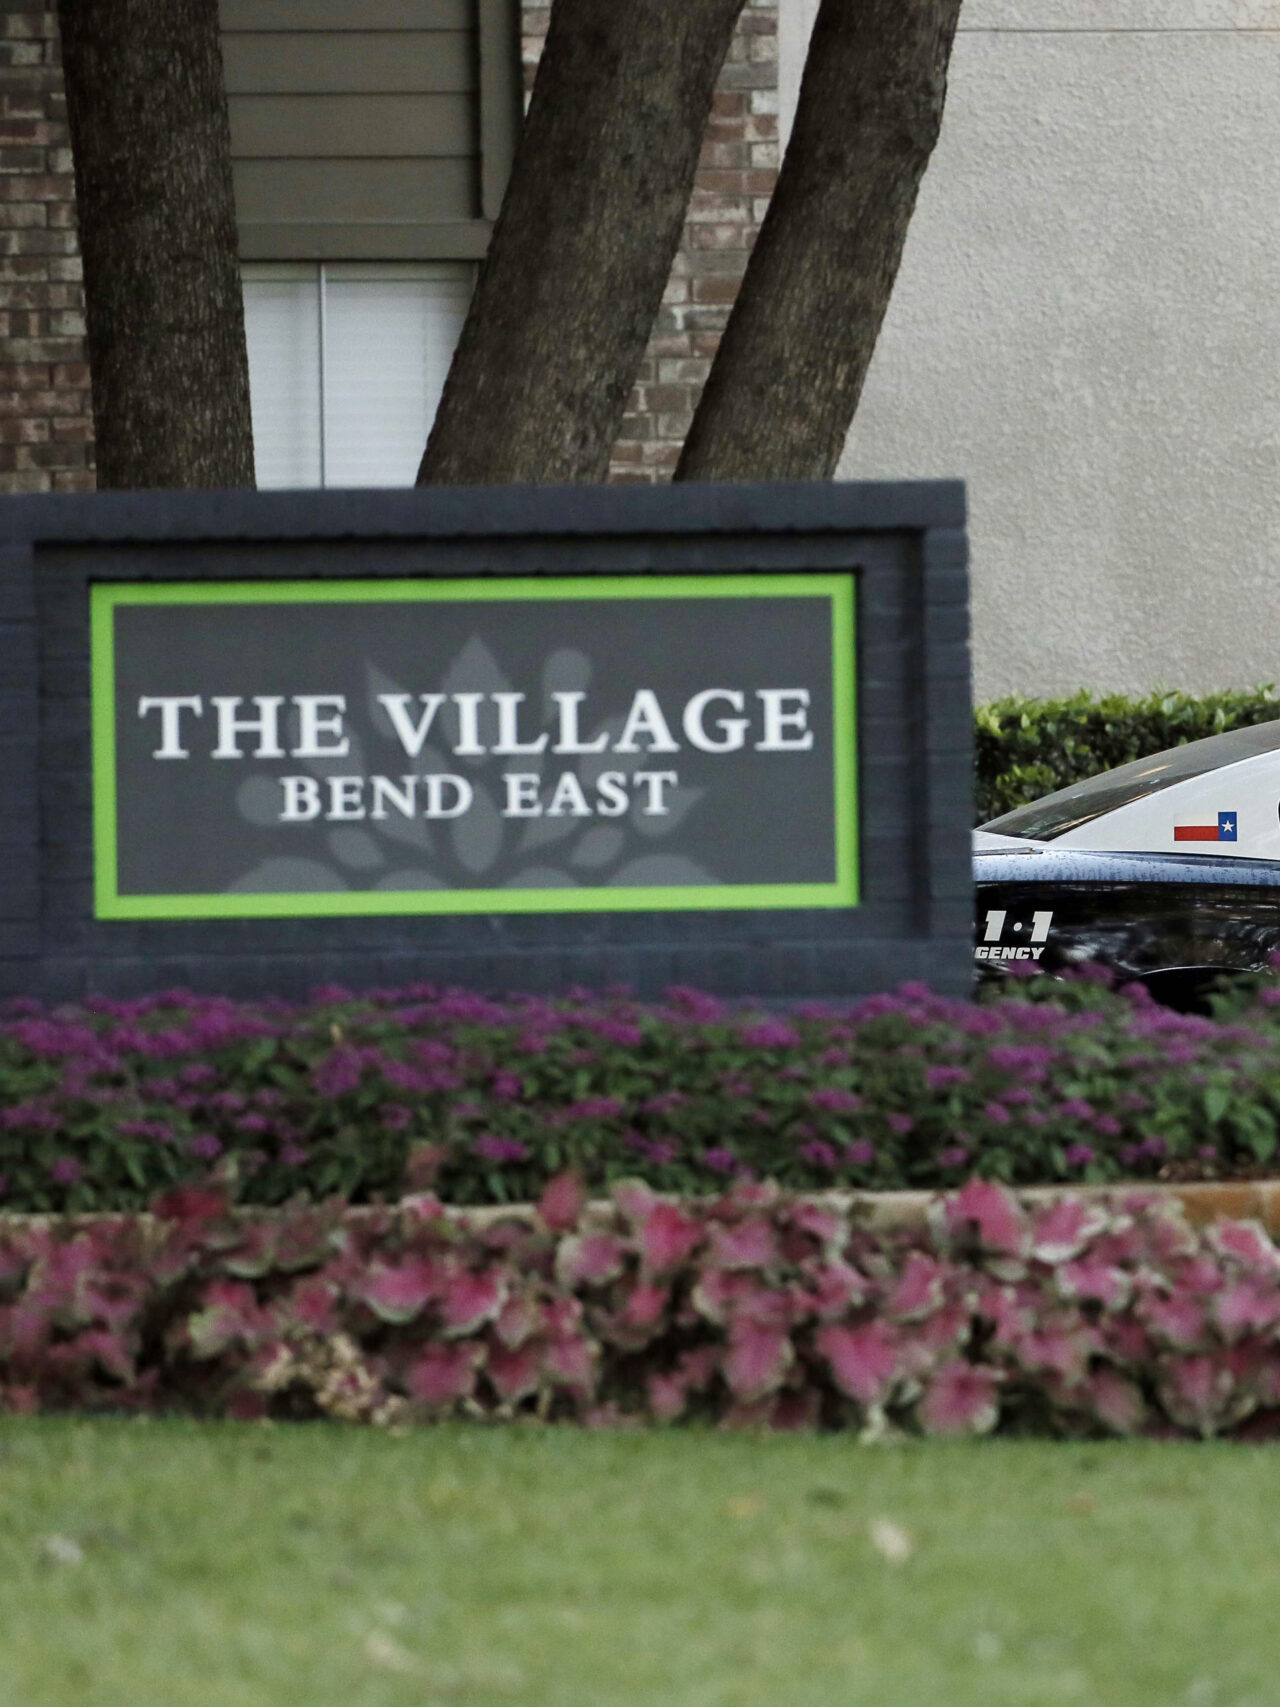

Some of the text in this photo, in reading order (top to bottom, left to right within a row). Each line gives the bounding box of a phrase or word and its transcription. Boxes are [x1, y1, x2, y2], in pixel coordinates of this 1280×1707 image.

[138, 688, 813, 760] THE VILLAGE
[278, 770, 679, 822] BEND EAST
